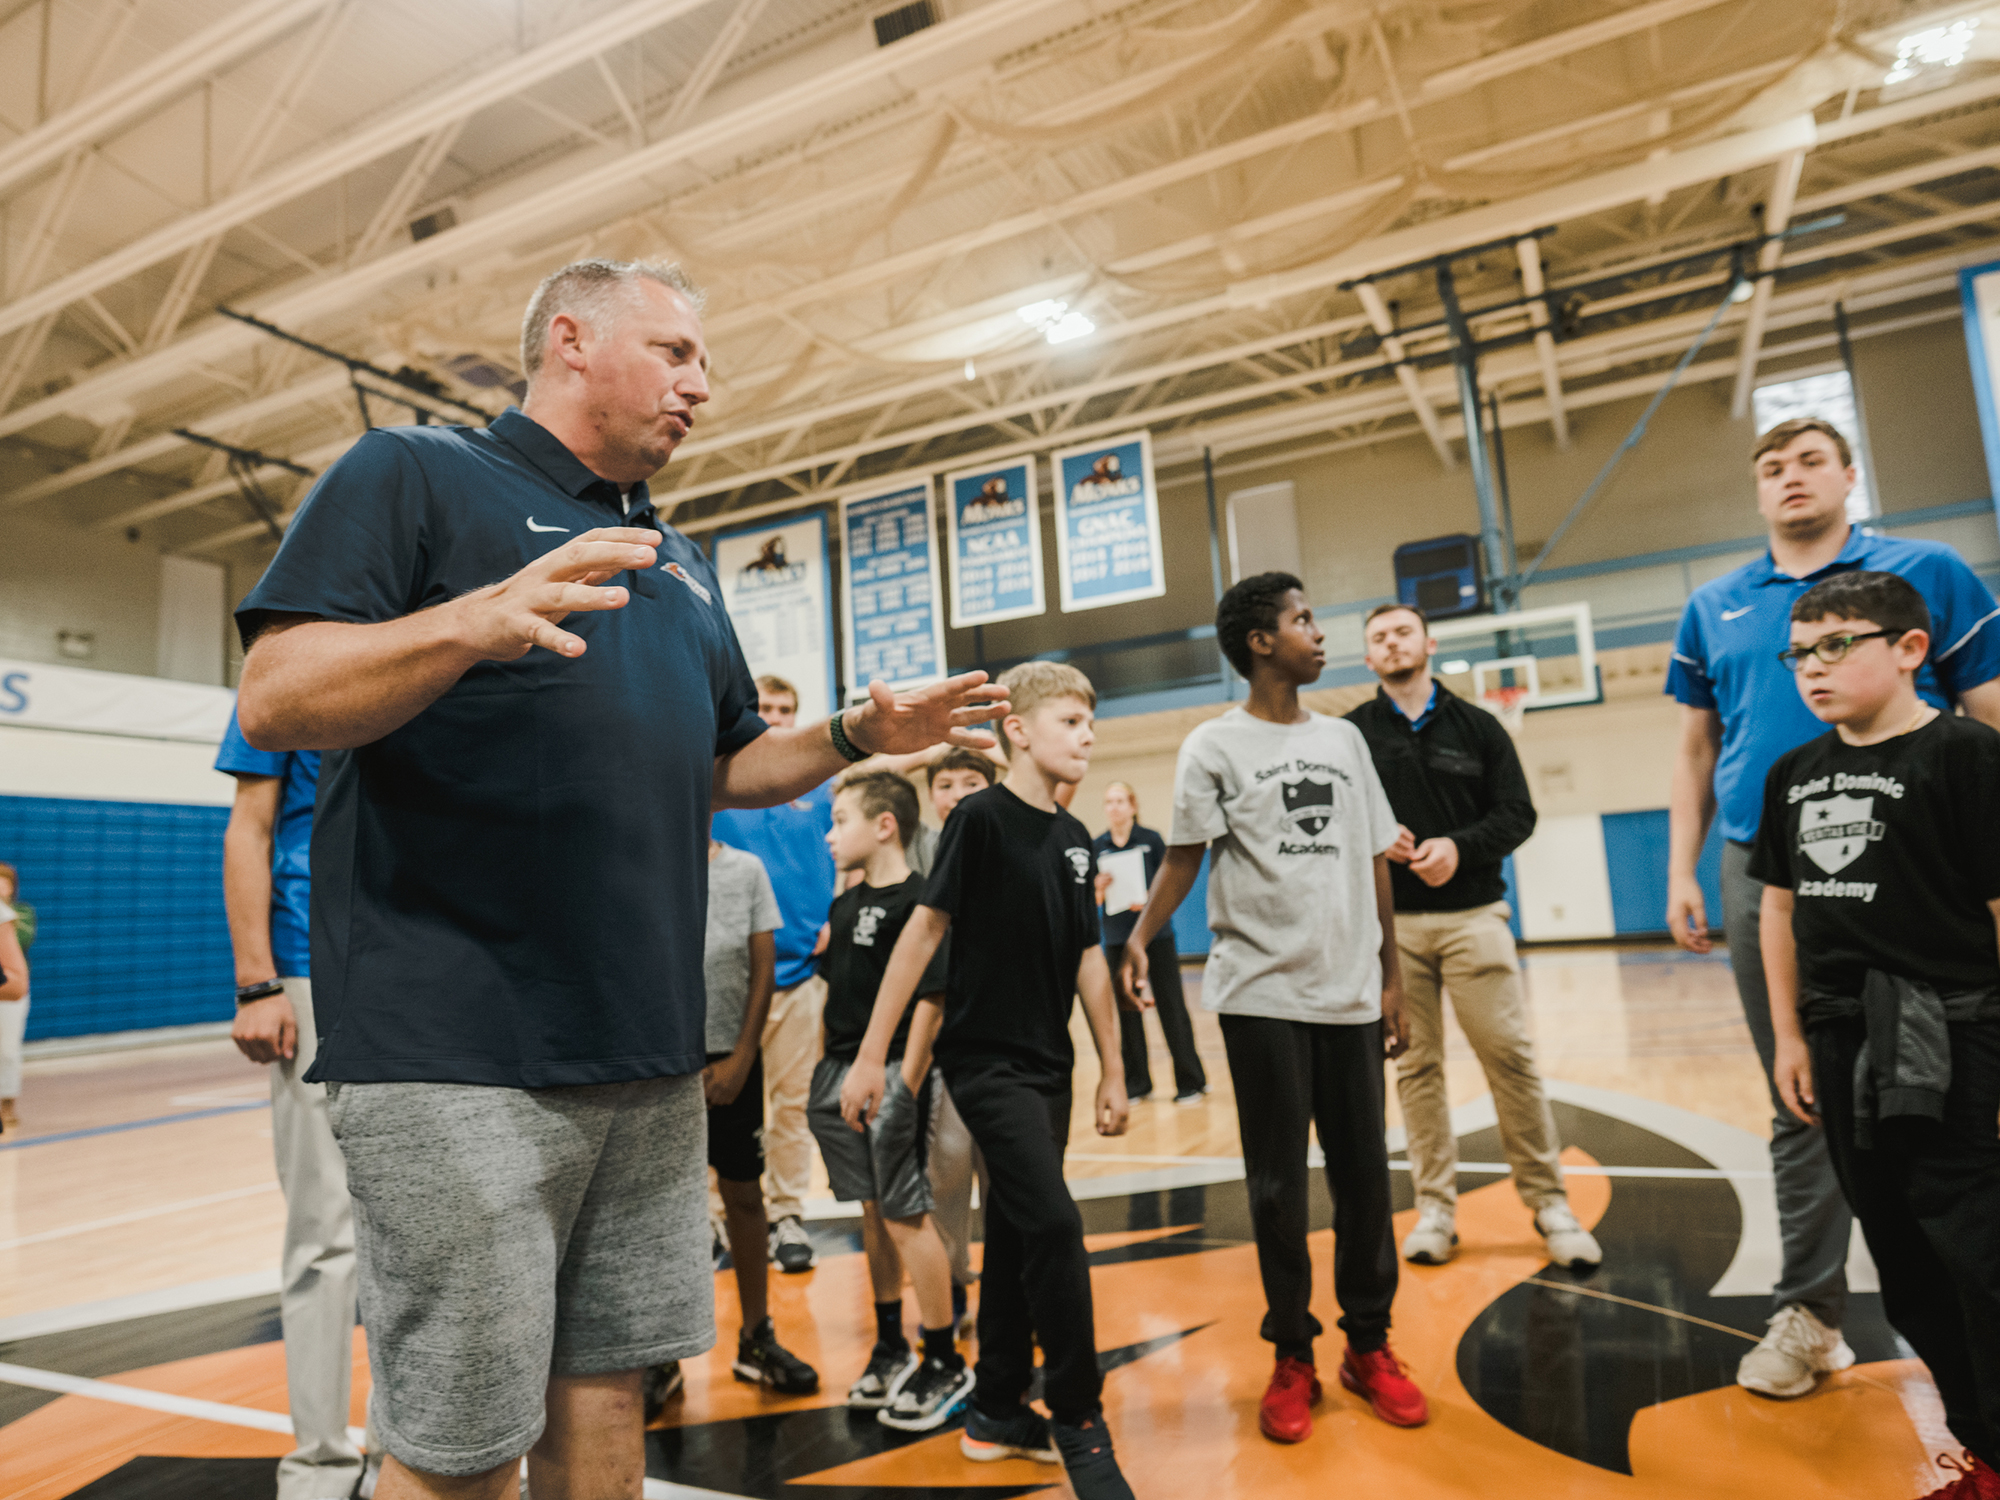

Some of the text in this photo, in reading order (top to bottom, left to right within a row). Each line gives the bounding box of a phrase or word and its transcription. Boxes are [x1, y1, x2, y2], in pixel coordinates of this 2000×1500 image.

[967, 530, 1020, 554] NCAA
[1255, 758, 1353, 787] Saint Dominic
[1787, 772, 1905, 805] Saint Dominic
[1278, 841, 1340, 860] Academy
